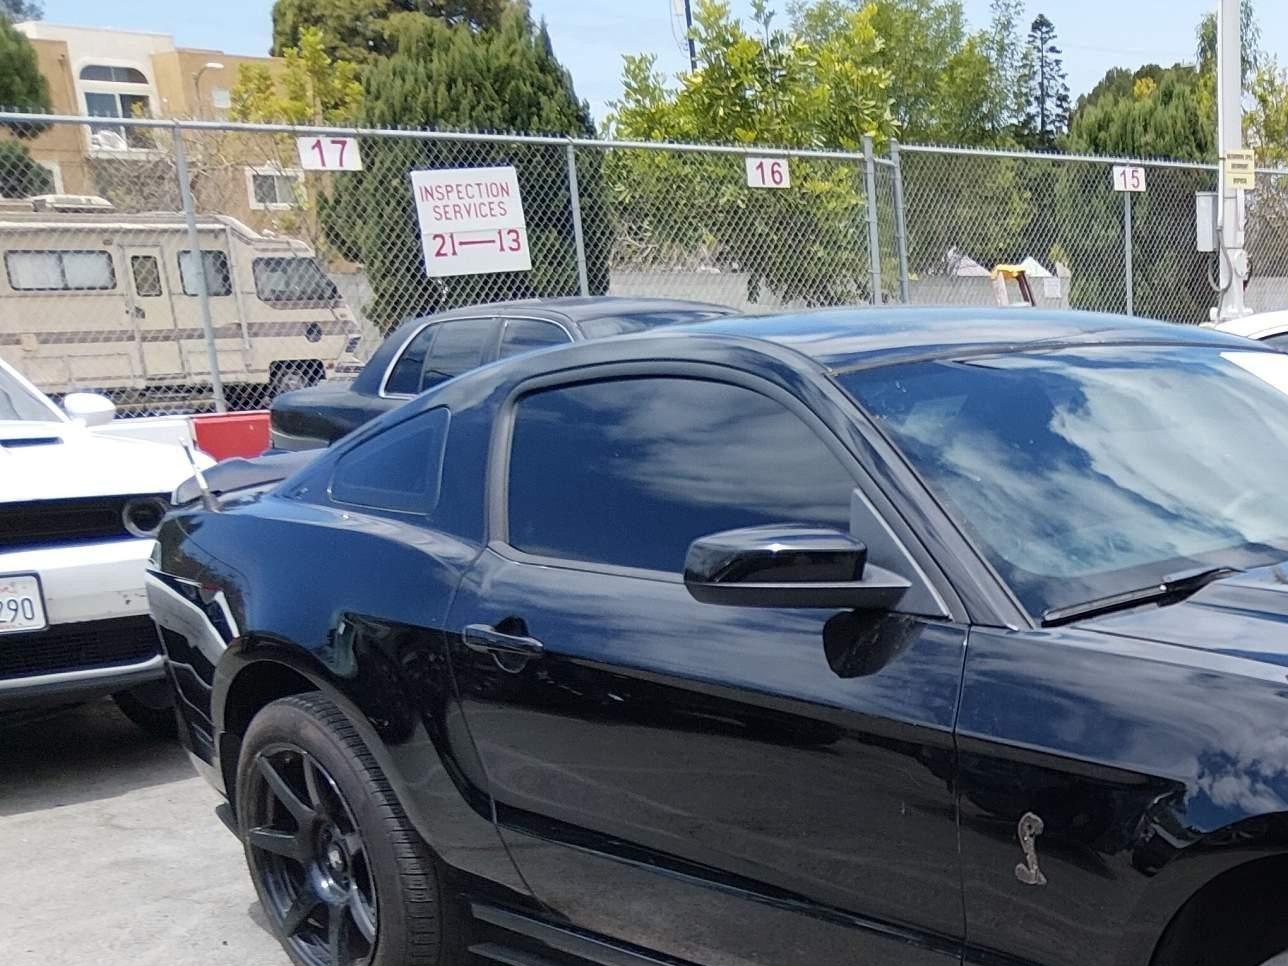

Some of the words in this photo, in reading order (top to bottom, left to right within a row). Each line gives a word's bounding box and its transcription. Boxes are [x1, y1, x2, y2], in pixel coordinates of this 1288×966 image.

[311, 139, 347, 168] 17
[755, 160, 783, 186] 16
[1120, 169, 1140, 189] 15
[419, 181, 511, 202] INSPECTION
[432, 201, 507, 221] SERVICES
